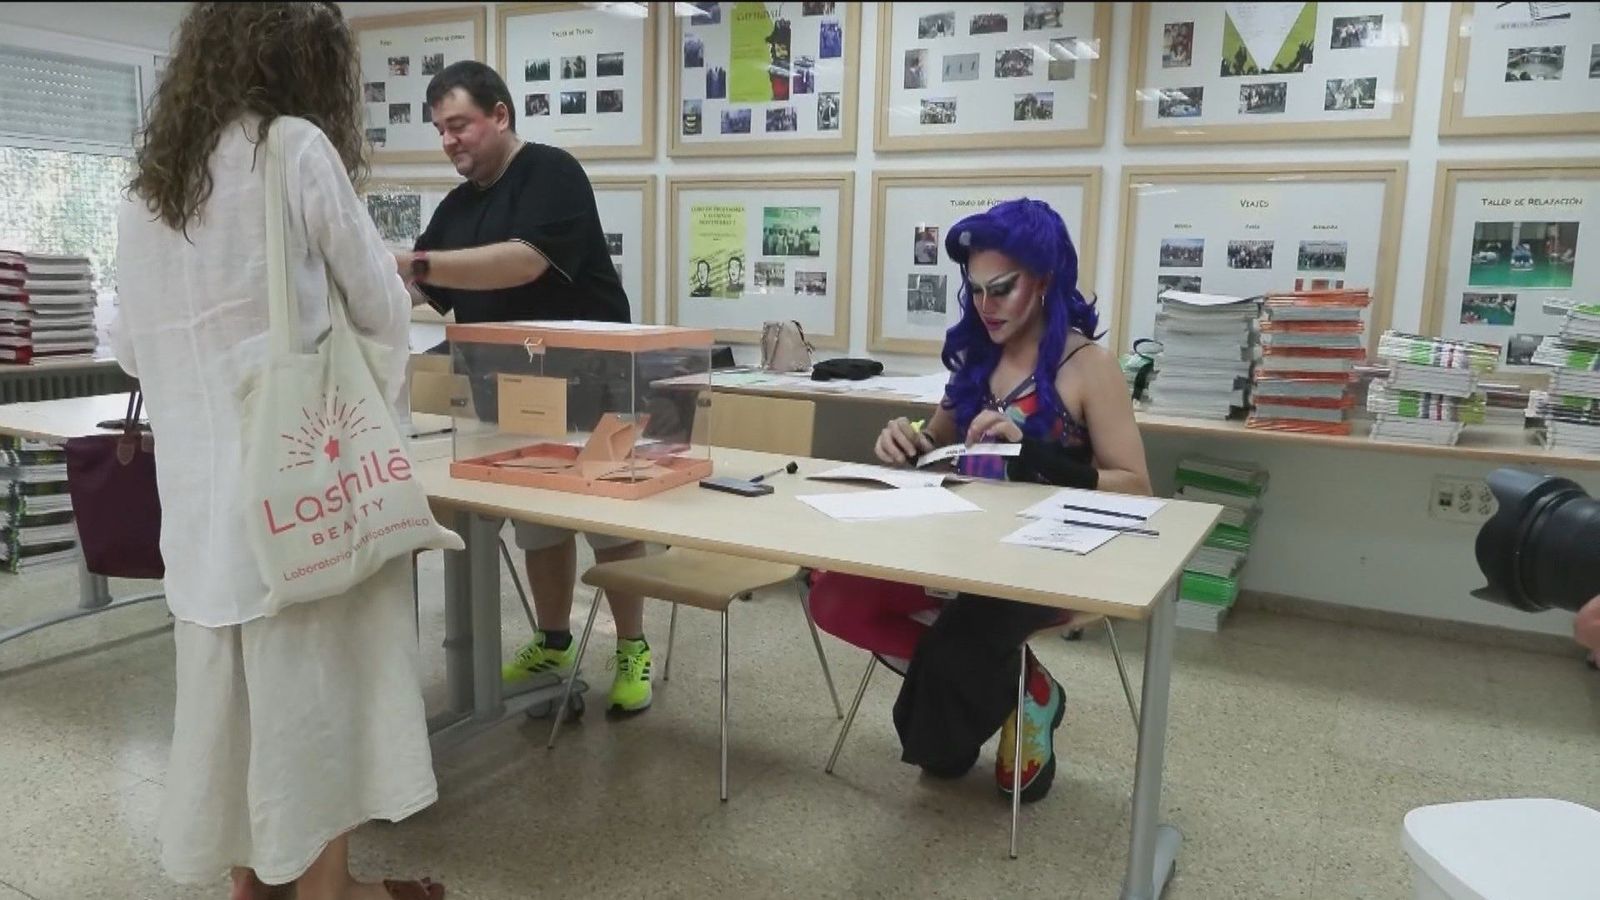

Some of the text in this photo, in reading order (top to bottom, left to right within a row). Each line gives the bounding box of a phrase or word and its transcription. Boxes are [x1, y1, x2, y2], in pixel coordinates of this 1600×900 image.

[1240, 199, 1270, 208] VIAJES
[1480, 198, 1511, 206] TALLER
[1513, 198, 1525, 206] DE
[282, 550, 353, 582] Laboratorio
